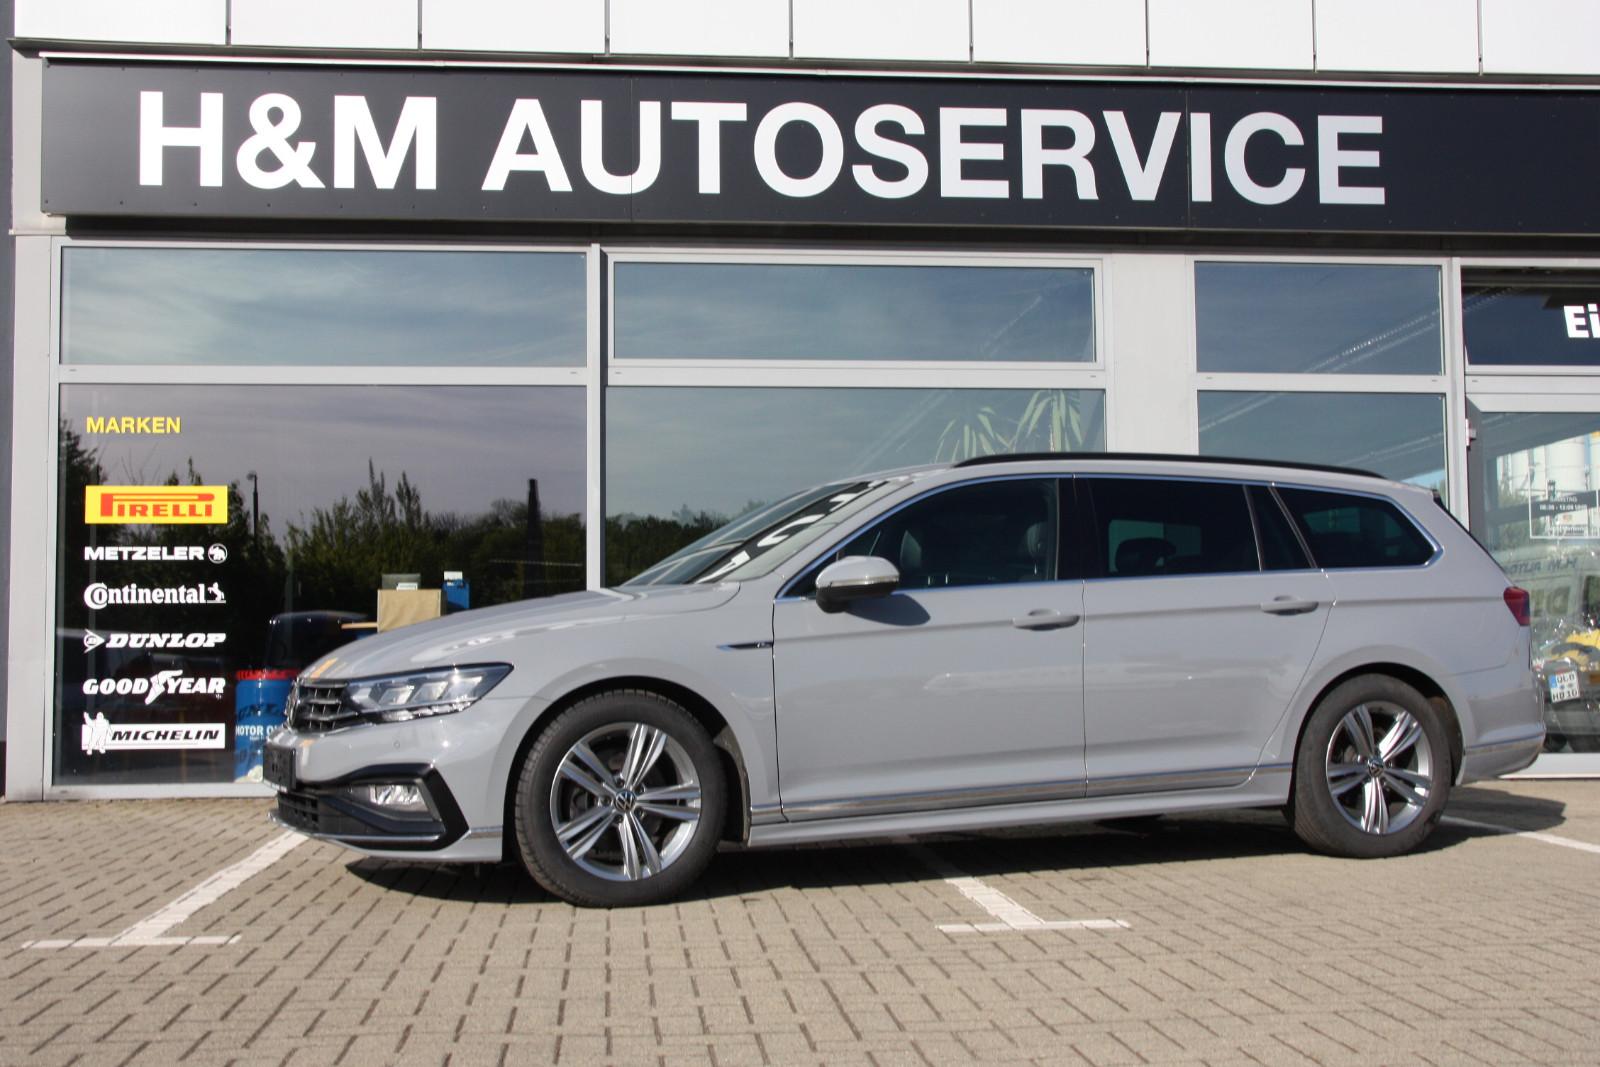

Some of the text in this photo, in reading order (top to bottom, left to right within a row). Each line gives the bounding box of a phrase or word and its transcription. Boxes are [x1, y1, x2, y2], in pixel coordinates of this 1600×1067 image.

[139, 90, 1386, 206] H&M AUTOSERVICE
[86, 416, 182, 434] MARKEN
[100, 493, 215, 518] PIRELLI
[84, 546, 205, 561] METZELER
[83, 582, 208, 610] Continental
[106, 633, 227, 648] DUNLOP
[111, 730, 219, 741] MICHELIN
[235, 725, 264, 736] MOTOR
